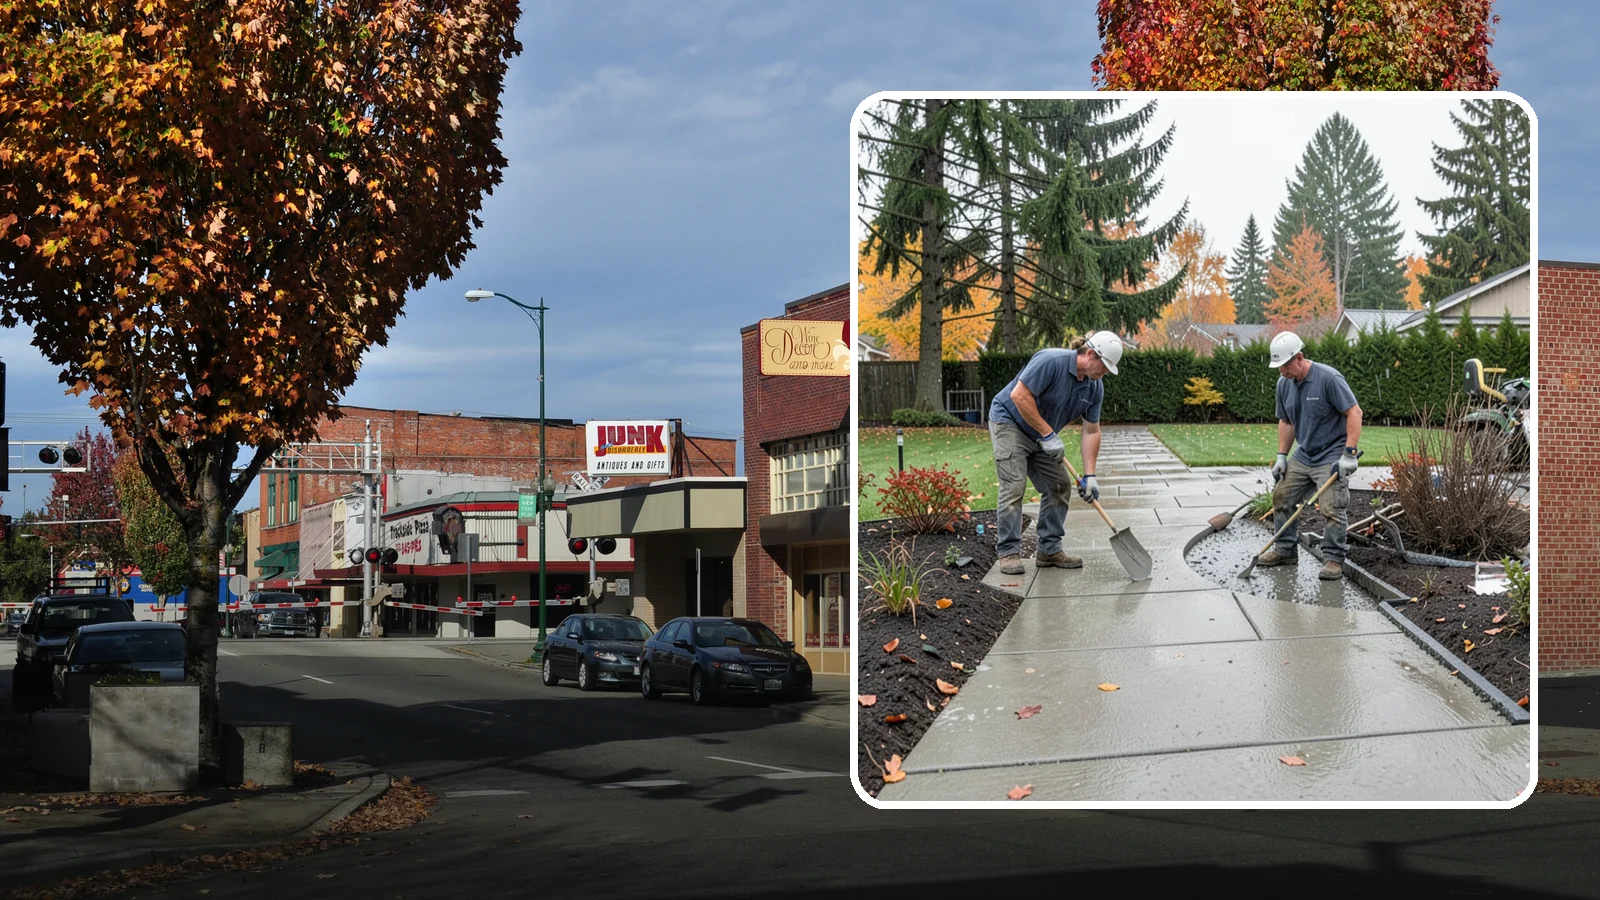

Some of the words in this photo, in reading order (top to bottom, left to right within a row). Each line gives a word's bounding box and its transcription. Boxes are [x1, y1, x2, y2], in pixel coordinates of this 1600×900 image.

[595, 425, 665, 457] JUNK
[607, 446, 646, 454] DISORDERLY
[596, 461, 628, 470] ANTIQUES
[631, 461, 643, 469] AND
[646, 460, 665, 469] GIFTS
[573, 473, 589, 491] RAIL
[414, 519, 429, 535] Pizza
